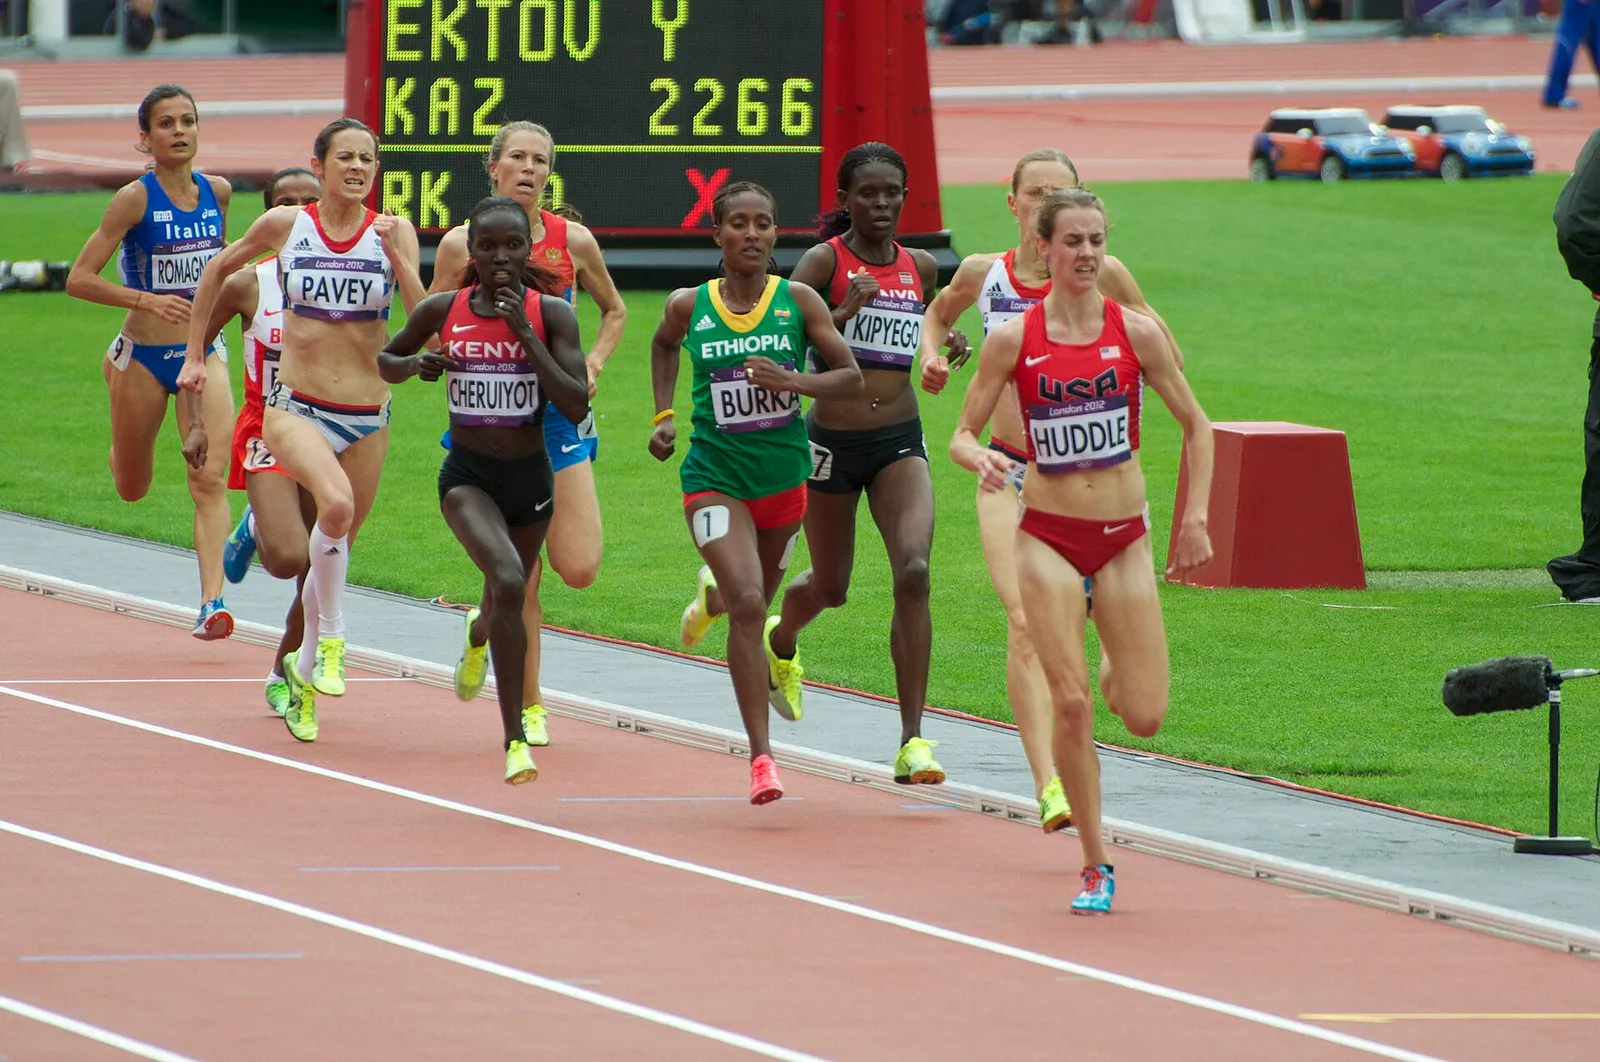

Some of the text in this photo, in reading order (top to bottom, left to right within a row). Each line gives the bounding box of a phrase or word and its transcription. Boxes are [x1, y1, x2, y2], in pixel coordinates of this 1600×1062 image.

[386, 0, 689, 62] EKTOV Y
[384, 77, 814, 137] KAZ 2266
[165, 221, 218, 240] Italia
[172, 239, 212, 253] London 2012
[315, 260, 365, 270] London 2012
[302, 275, 374, 305] PAVEY
[873, 298, 914, 311] London 2012
[852, 313, 920, 350] KIPYEGO
[113, 337, 125, 361] 9
[701, 334, 792, 359] ETHIOPIA
[466, 362, 517, 372] London 2012
[268, 380, 283, 407] 8
[450, 378, 536, 410] CHERUIYOT
[1038, 366, 1119, 403] USA
[1049, 400, 1107, 416] London 2012
[1033, 415, 1126, 457] HUDDLE
[815, 449, 830, 477] 7
[702, 510, 712, 538] 1
